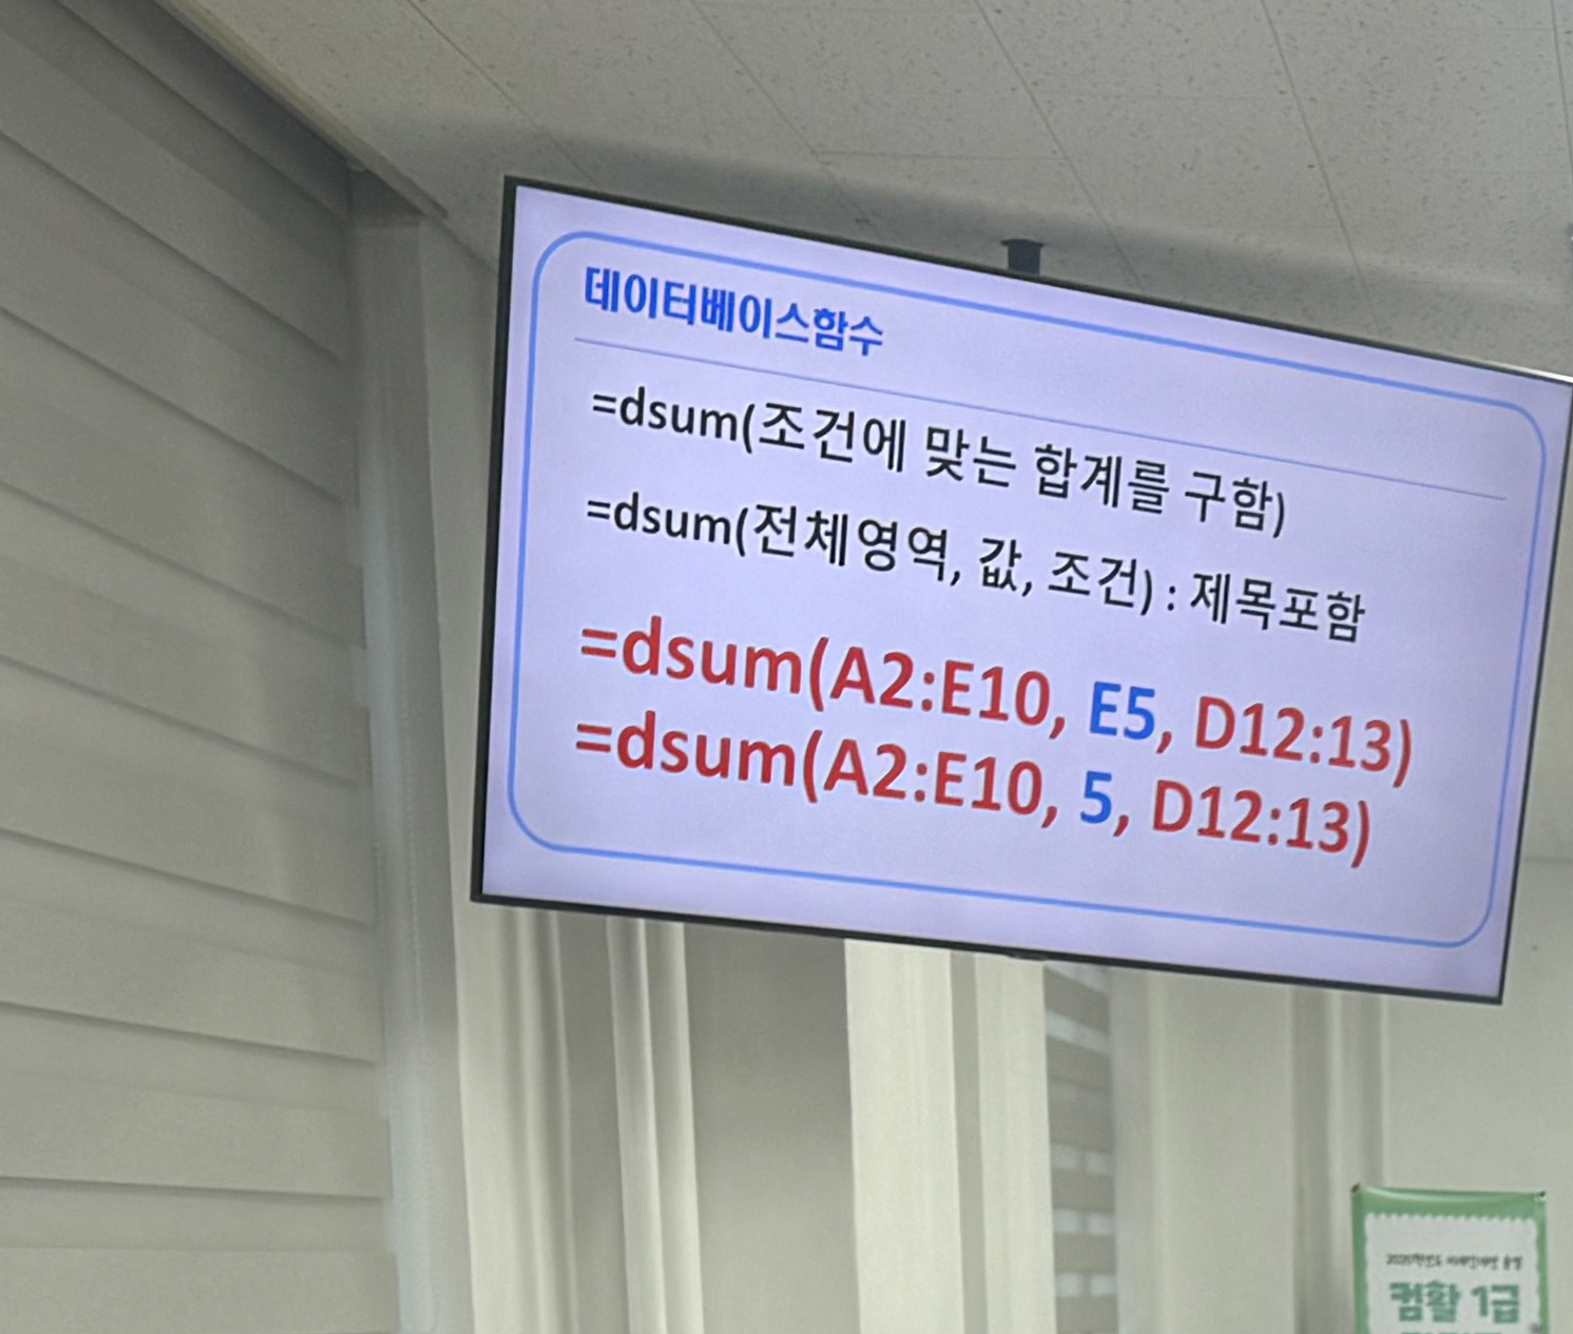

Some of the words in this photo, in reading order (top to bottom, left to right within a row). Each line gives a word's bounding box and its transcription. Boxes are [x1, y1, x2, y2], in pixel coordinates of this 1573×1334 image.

[583, 265, 885, 357] 데이터베이스함수
[592, 385, 906, 475] =dsum(조건에
[924, 425, 1018, 491] 맞는
[1034, 443, 1171, 517] 합계를
[1184, 469, 1287, 538] 구함)
[587, 491, 962, 588] =dsum(전체영역,
[978, 536, 1034, 597] 값,
[1048, 553, 1154, 617] 조건)
[1190, 568, 1366, 644] 제목포함
[580, 615, 1068, 740] =dsum(A2:E10,
[1088, 678, 1173, 754] E5,
[1196, 694, 1413, 788] D12:13)
[575, 707, 1059, 830] =dsum(A2:E10,
[1079, 768, 1131, 839] 5,
[1151, 776, 1373, 869] D12:13)
[1389, 1281, 1461, 1322] 컴활
[1471, 1284, 1520, 1323] 1급
